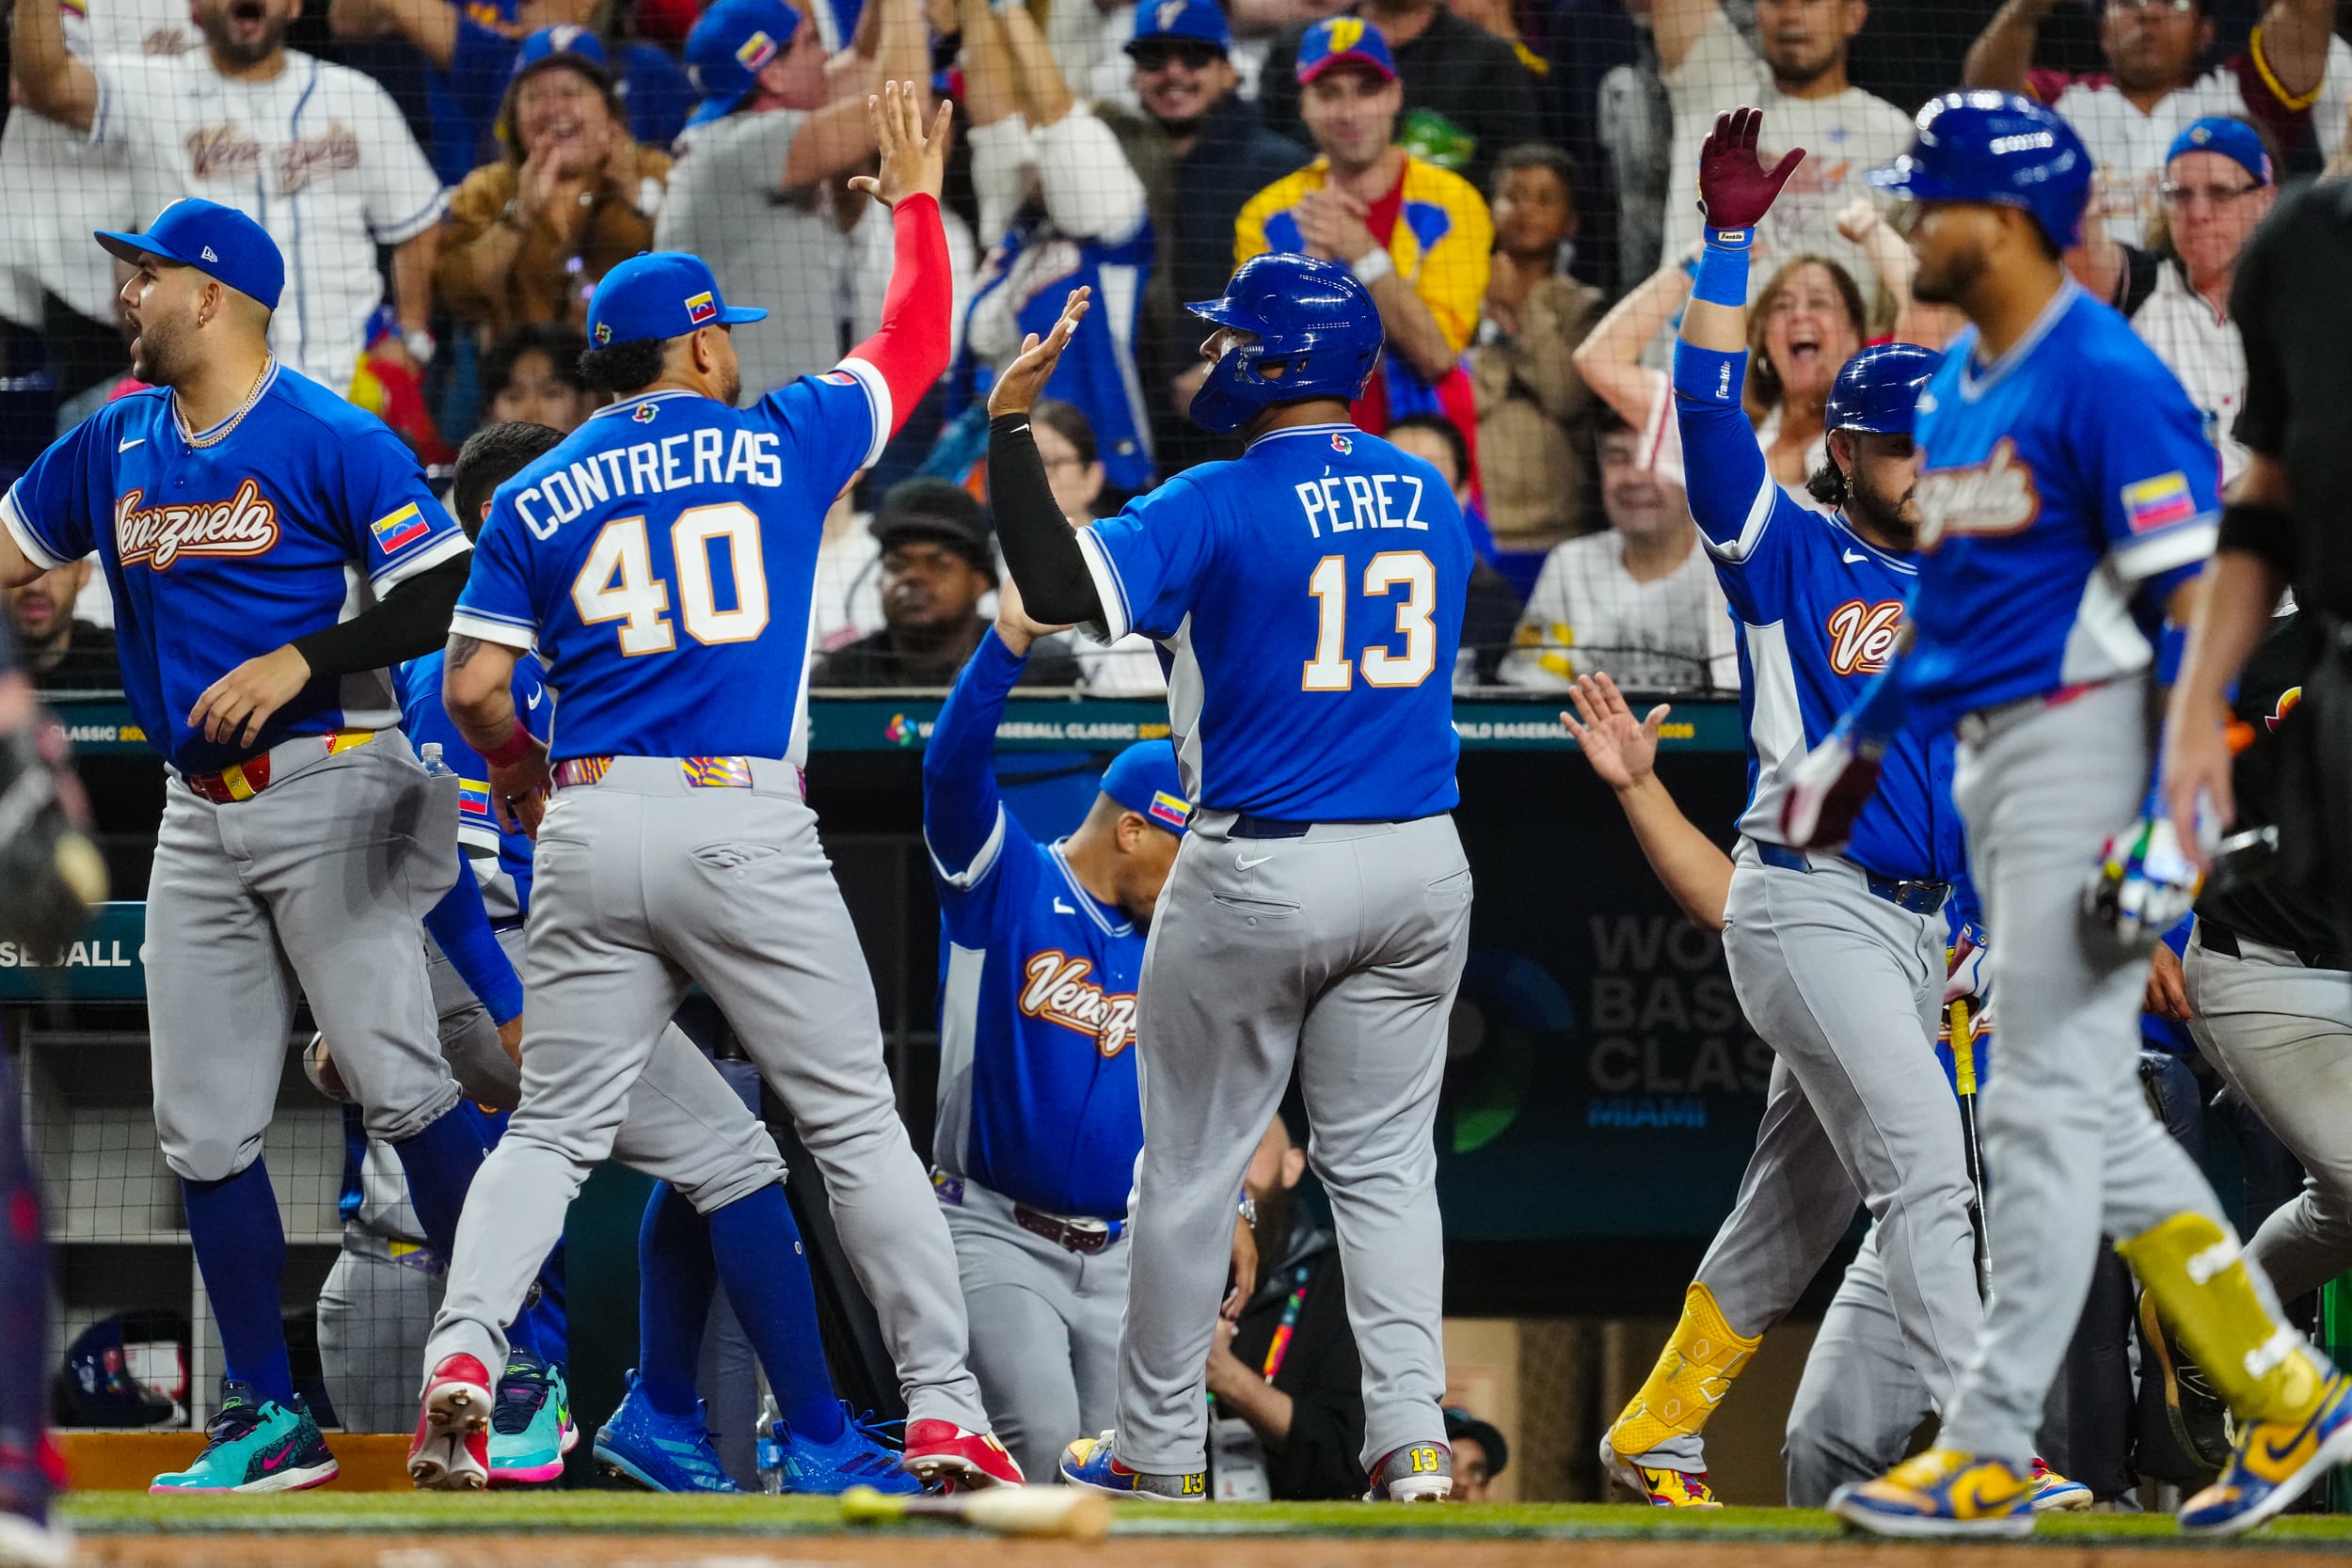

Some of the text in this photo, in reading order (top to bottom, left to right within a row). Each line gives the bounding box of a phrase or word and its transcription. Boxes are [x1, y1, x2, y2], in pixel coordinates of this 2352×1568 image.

[515, 428, 783, 541] CONTRERAS
[1295, 465, 1429, 539] PÉREZ
[570, 501, 771, 657] 40
[1301, 550, 1437, 692] 13
[995, 722, 1065, 739] ASEBALL
[1066, 722, 1136, 739] CLASSIC
[1589, 915, 1721, 971] WO
[1021, 952, 1137, 1055] Venez
[1592, 976, 1740, 1033] BAS
[1589, 1037, 1775, 1093] CLAS
[1181, 1473, 1204, 1496] 13
[1410, 1448, 1439, 1474] 13
